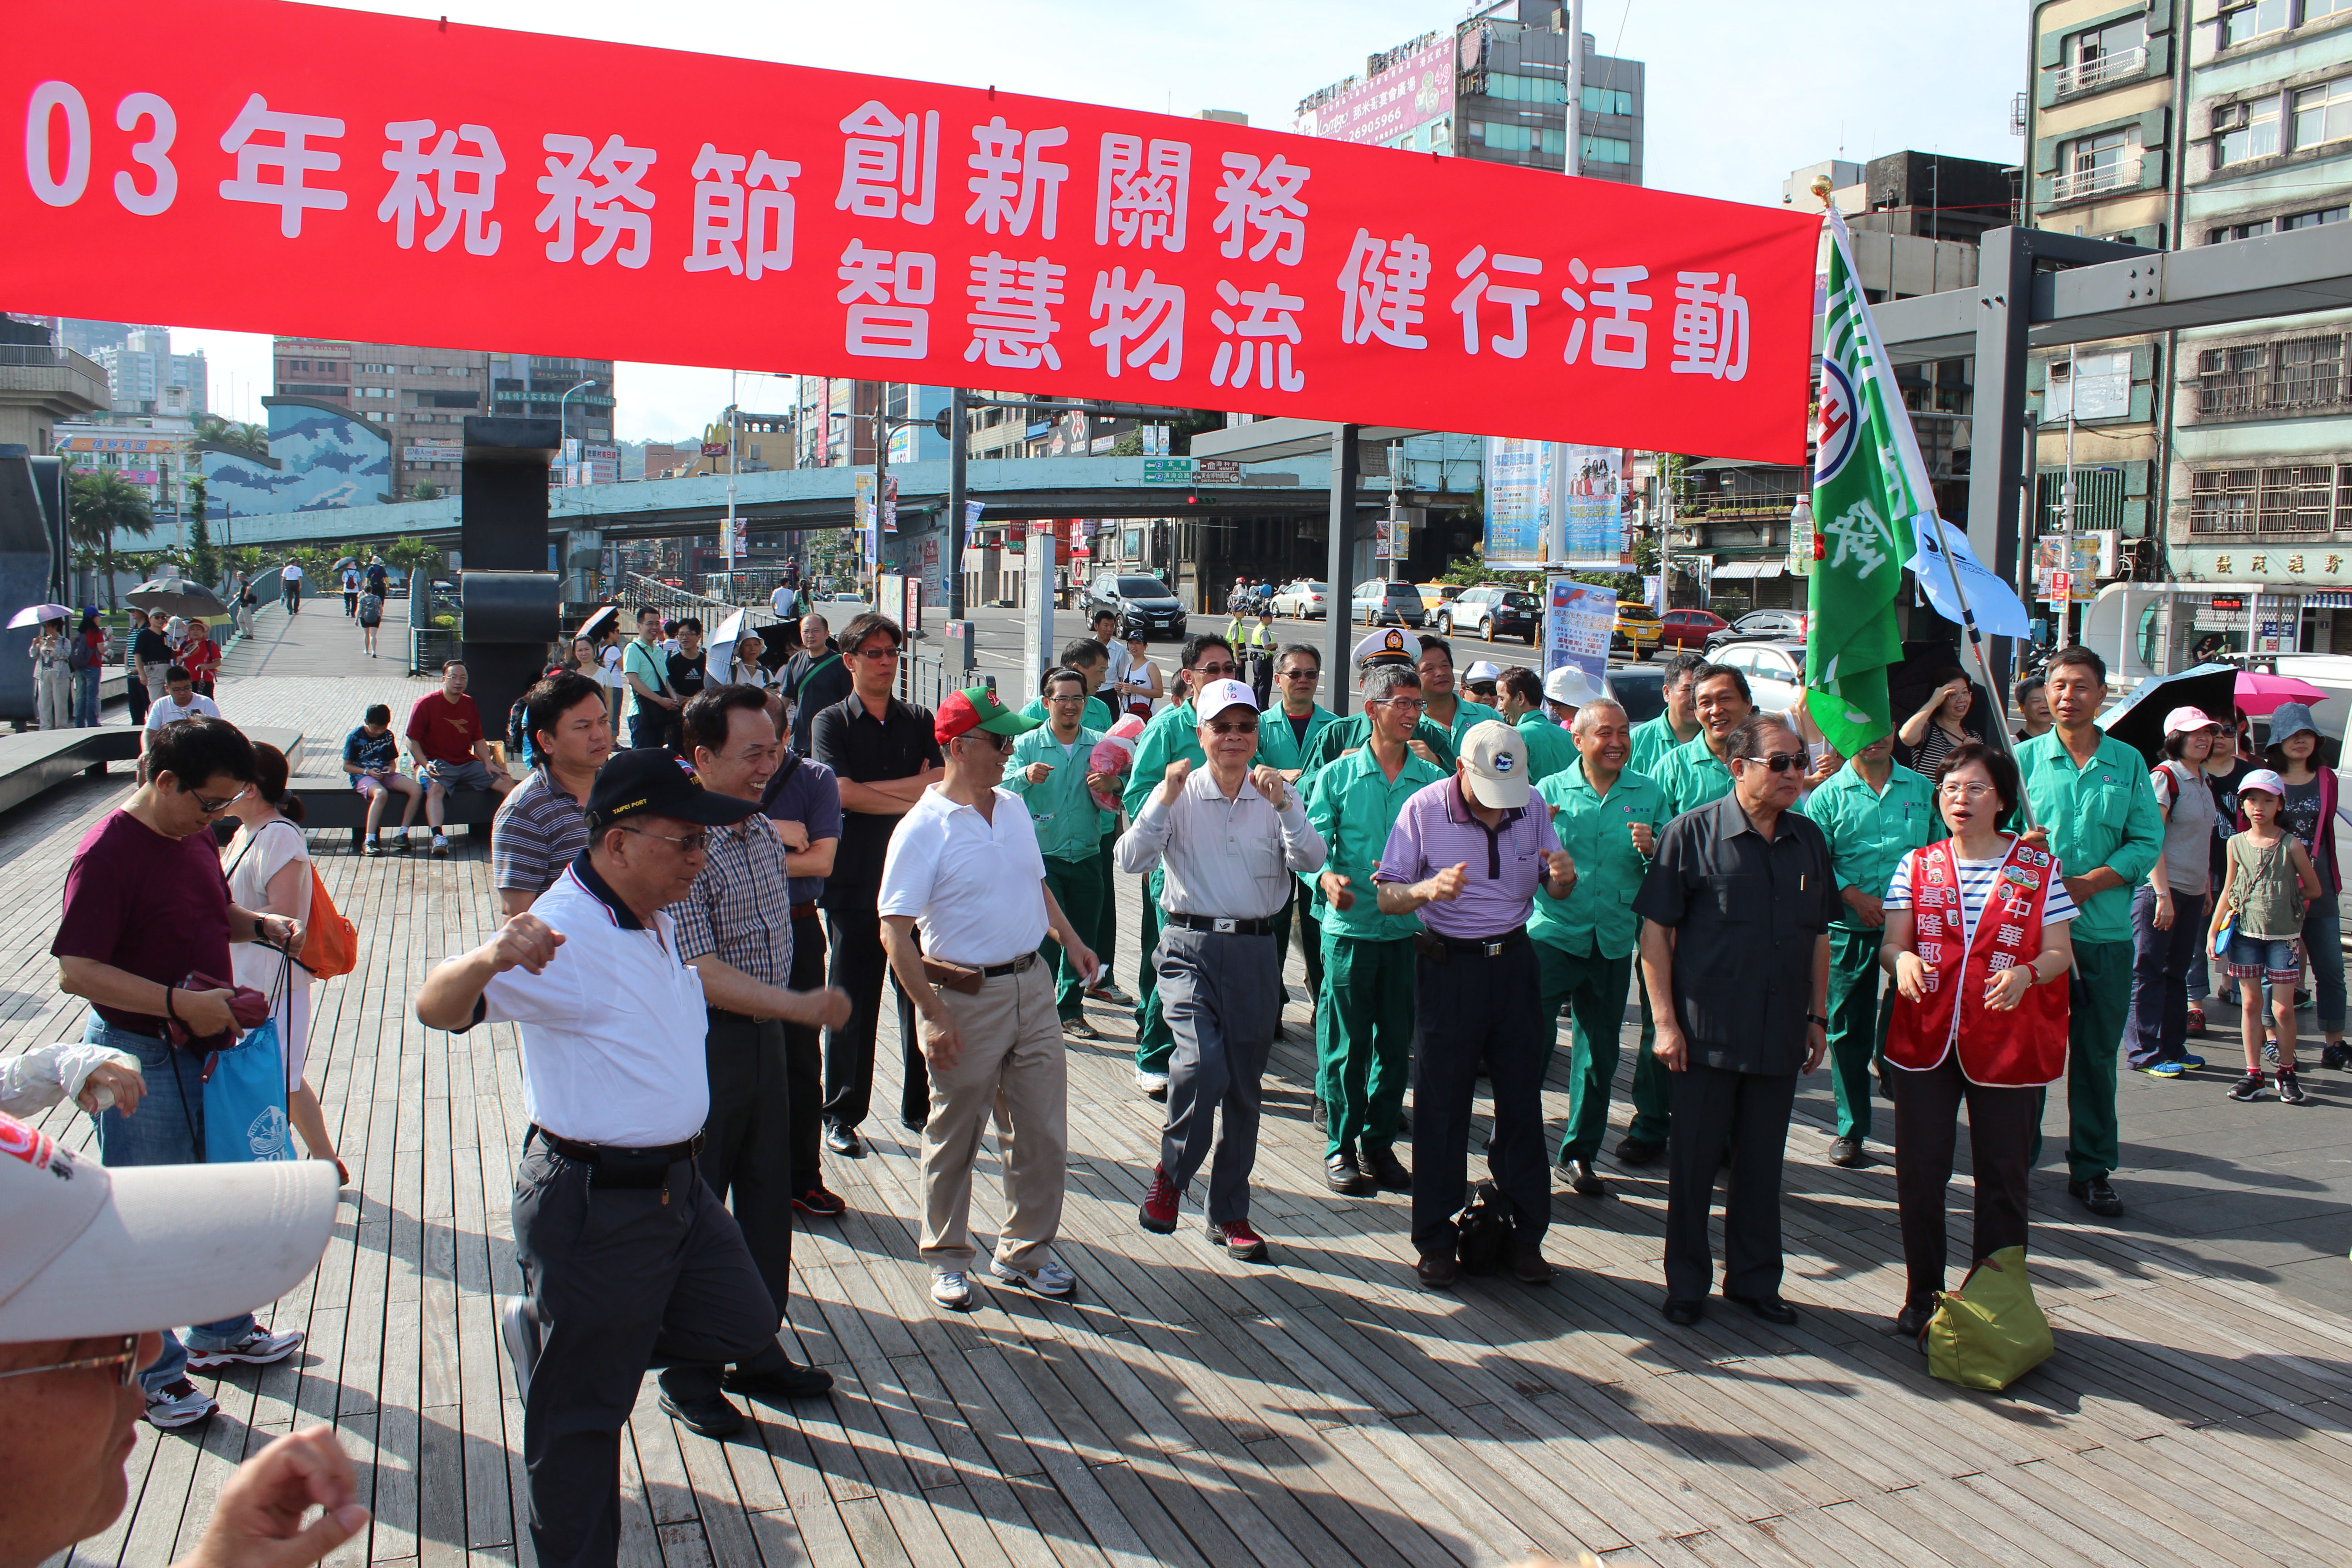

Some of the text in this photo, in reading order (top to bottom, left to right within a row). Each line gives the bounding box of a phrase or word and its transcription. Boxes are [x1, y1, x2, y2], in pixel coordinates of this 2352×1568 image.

[1420, 43, 1450, 68] 港式飲茶
[1435, 63, 1451, 85] 49
[1353, 76, 1416, 122] 那米哥宴會廣場
[1318, 112, 1349, 136] Lamigo
[27, 81, 802, 281] 03年稅務節
[836, 100, 1311, 266] 創新關務
[838, 238, 1305, 392] 智慧物流
[1337, 228, 1749, 382] 健行活動
[1071, 440, 1085, 453] GAMES
[1493, 453, 1534, 466] 基隆航海節
[1555, 609, 1612, 625] 國軍推動募兵政策
[1561, 617, 1610, 632] 暨人才招募活動
[612, 799, 647, 814] TAIPEI PORT
[1982, 897, 2032, 998] 中華郵
